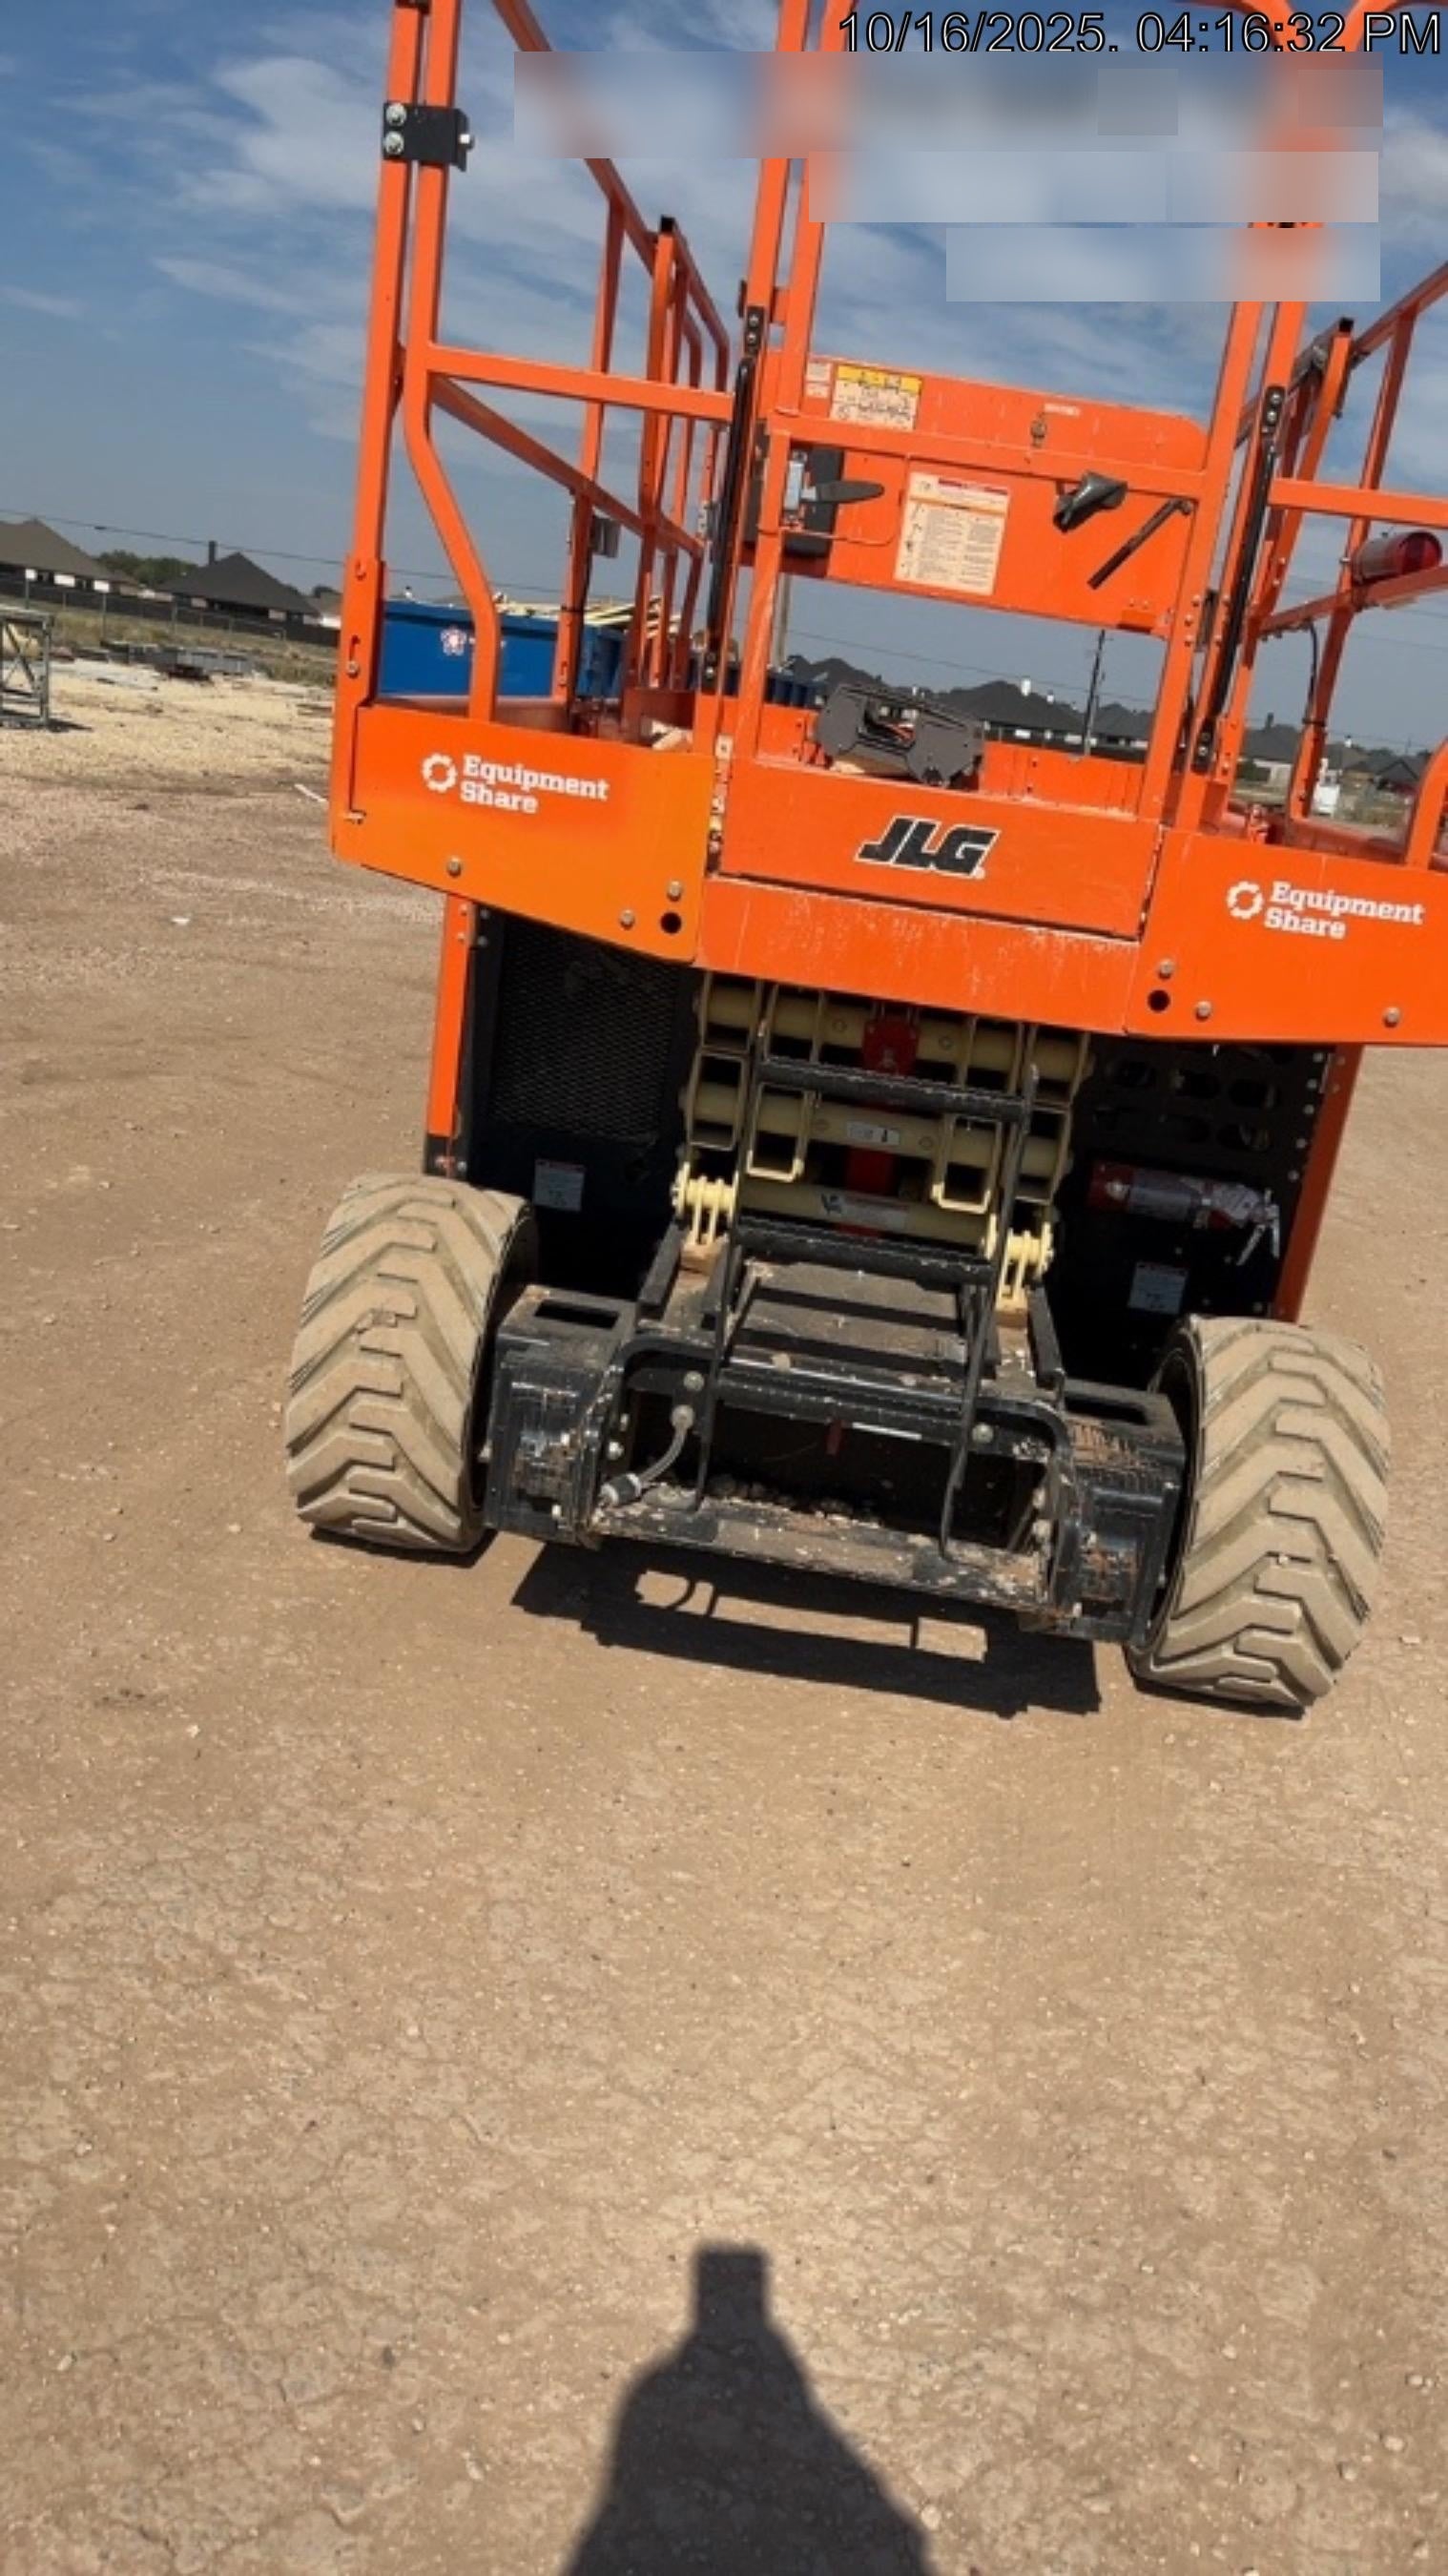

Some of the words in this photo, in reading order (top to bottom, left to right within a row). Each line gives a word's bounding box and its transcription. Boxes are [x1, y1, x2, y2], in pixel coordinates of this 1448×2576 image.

[460, 780, 539, 814] Share
[462, 754, 610, 801] Equipment
[854, 816, 1002, 880] JLG
[1264, 907, 1347, 940] Share
[1270, 881, 1425, 924] Equipment
